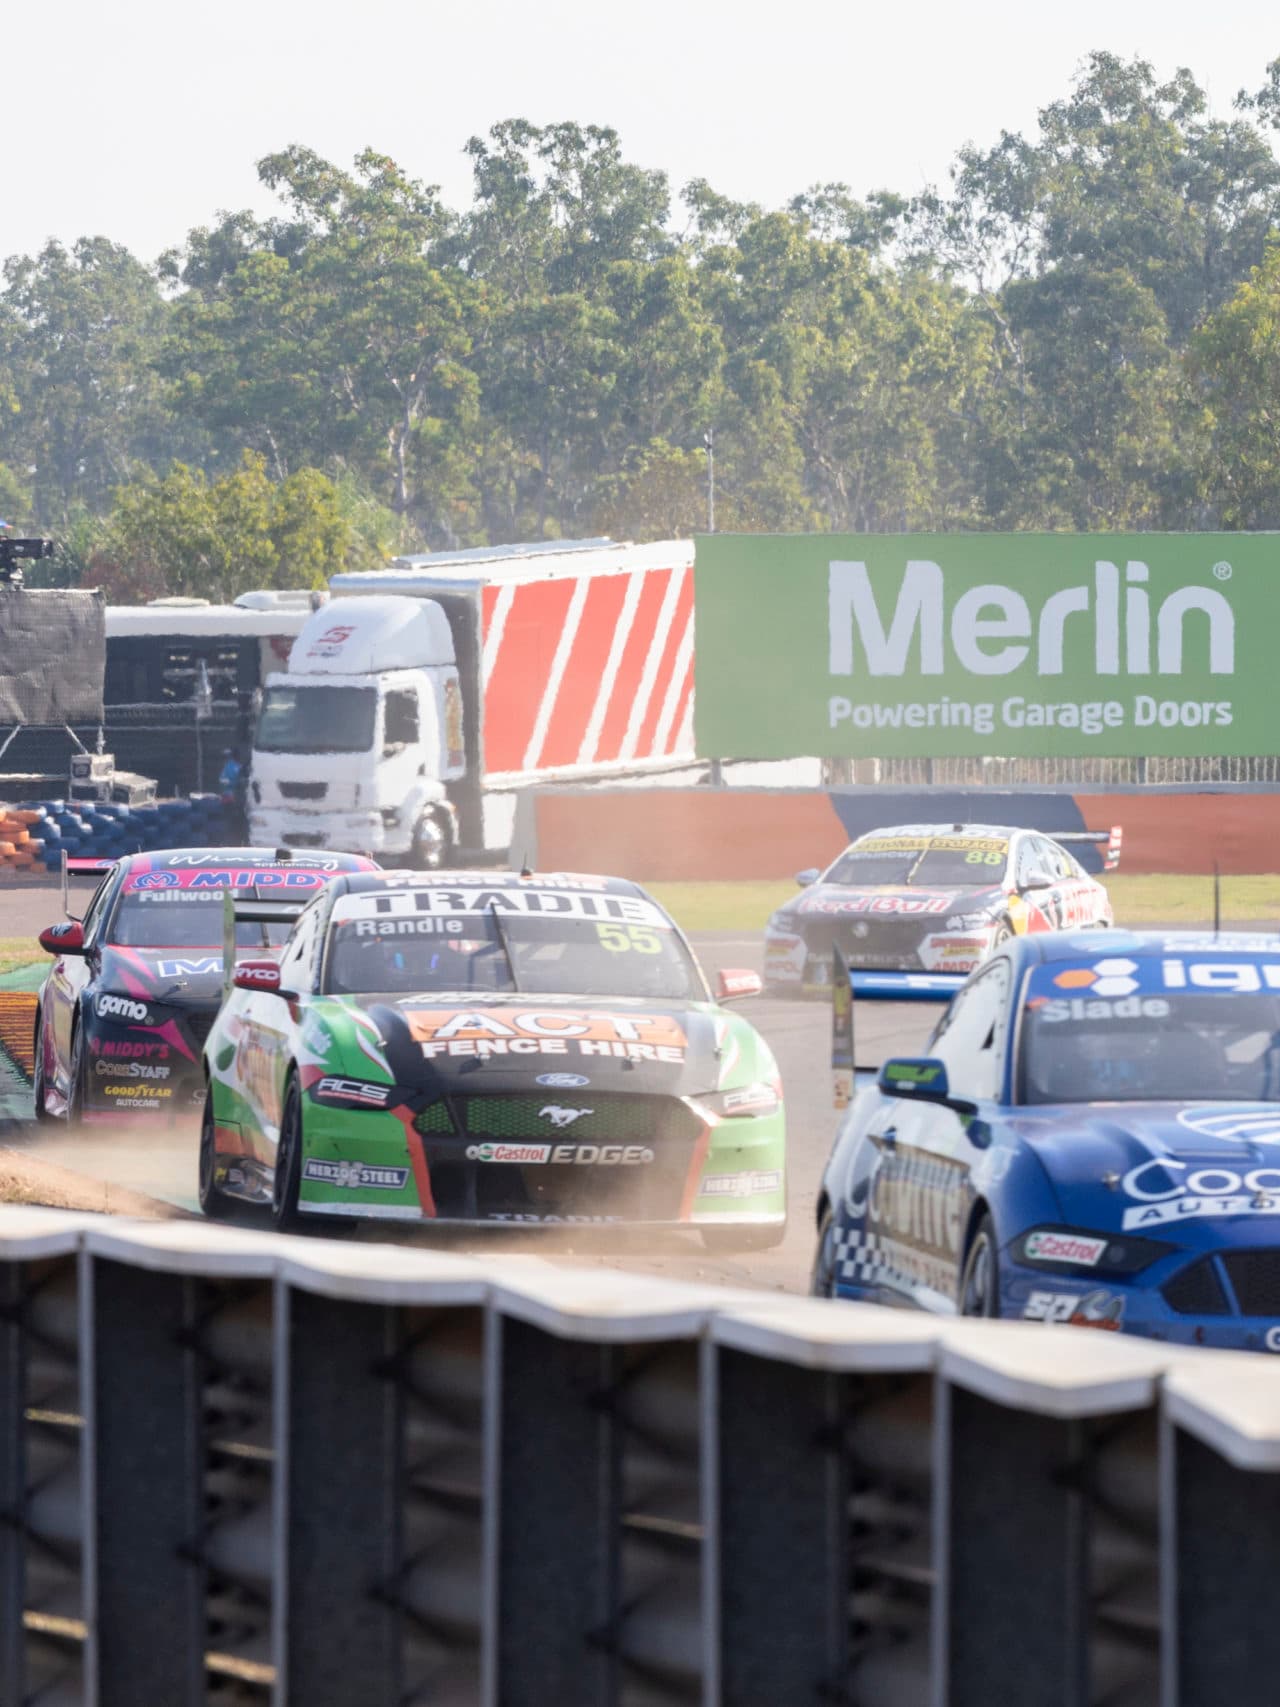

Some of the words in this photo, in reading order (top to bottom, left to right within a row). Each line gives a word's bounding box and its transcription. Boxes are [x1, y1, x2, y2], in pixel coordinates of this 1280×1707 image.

[828, 559, 1235, 676] Merlin
[829, 696, 994, 733] Powering
[1002, 697, 1123, 733] Garage
[1135, 695, 1233, 727] Doors
[964, 851, 1002, 865] 88
[362, 892, 646, 922] TRADIE
[356, 917, 463, 937] Randle
[595, 924, 663, 954] 55
[1042, 998, 1169, 1022] Slade
[434, 1012, 654, 1041] ACT
[421, 1038, 568, 1058] FENCE
[577, 1039, 686, 1064] HIRE
[494, 1146, 546, 1160] Castrol
[551, 1145, 646, 1164] EDGE
